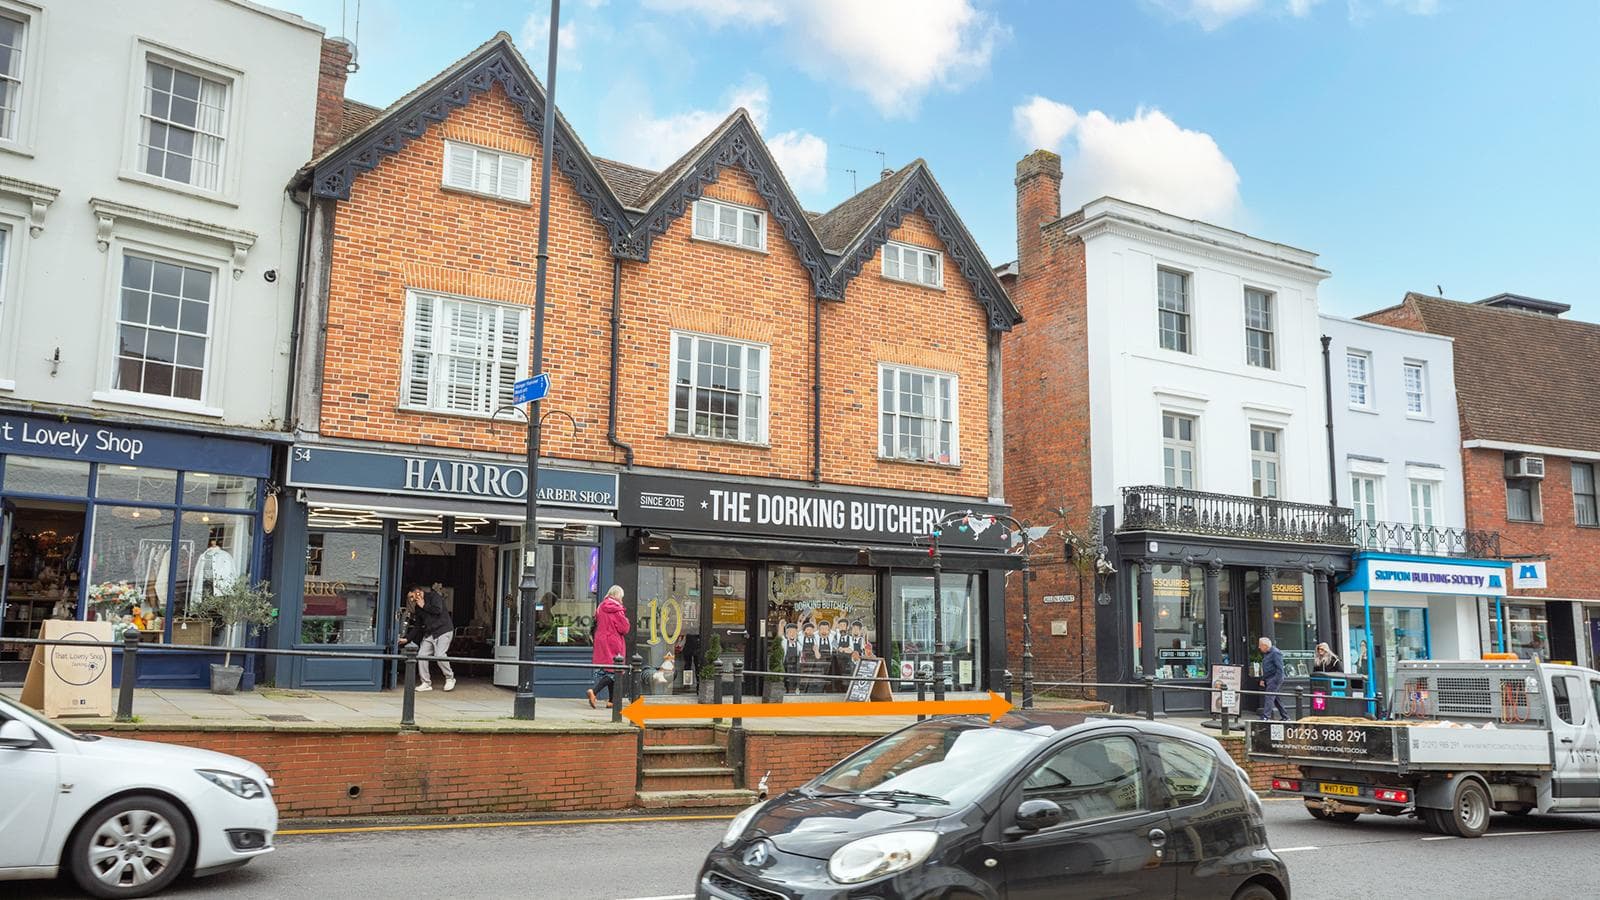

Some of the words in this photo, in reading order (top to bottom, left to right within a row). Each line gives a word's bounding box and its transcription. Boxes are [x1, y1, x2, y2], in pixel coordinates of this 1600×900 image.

[22, 421, 88, 455] Lovely
[95, 430, 144, 459] Shop
[294, 449, 311, 462] 54
[403, 457, 528, 498] HAIRRO
[536, 487, 578, 502] ARBER
[640, 495, 663, 506] SINCE
[664, 497, 685, 508] 2015
[709, 489, 751, 523] THE
[757, 493, 845, 529] DORKING
[850, 501, 946, 535] BUTCHERY
[1152, 578, 1190, 588] ESQUIRES
[1374, 569, 1411, 581] SKIPTON
[1411, 571, 1450, 584] BUILDING
[1451, 574, 1485, 587] SOCIETY
[1271, 583, 1304, 593] ESQUIRES
[646, 597, 682, 645] 10
[1286, 727, 1318, 740] 01293
[1322, 729, 1343, 741] 988
[1346, 730, 1367, 743] 291
